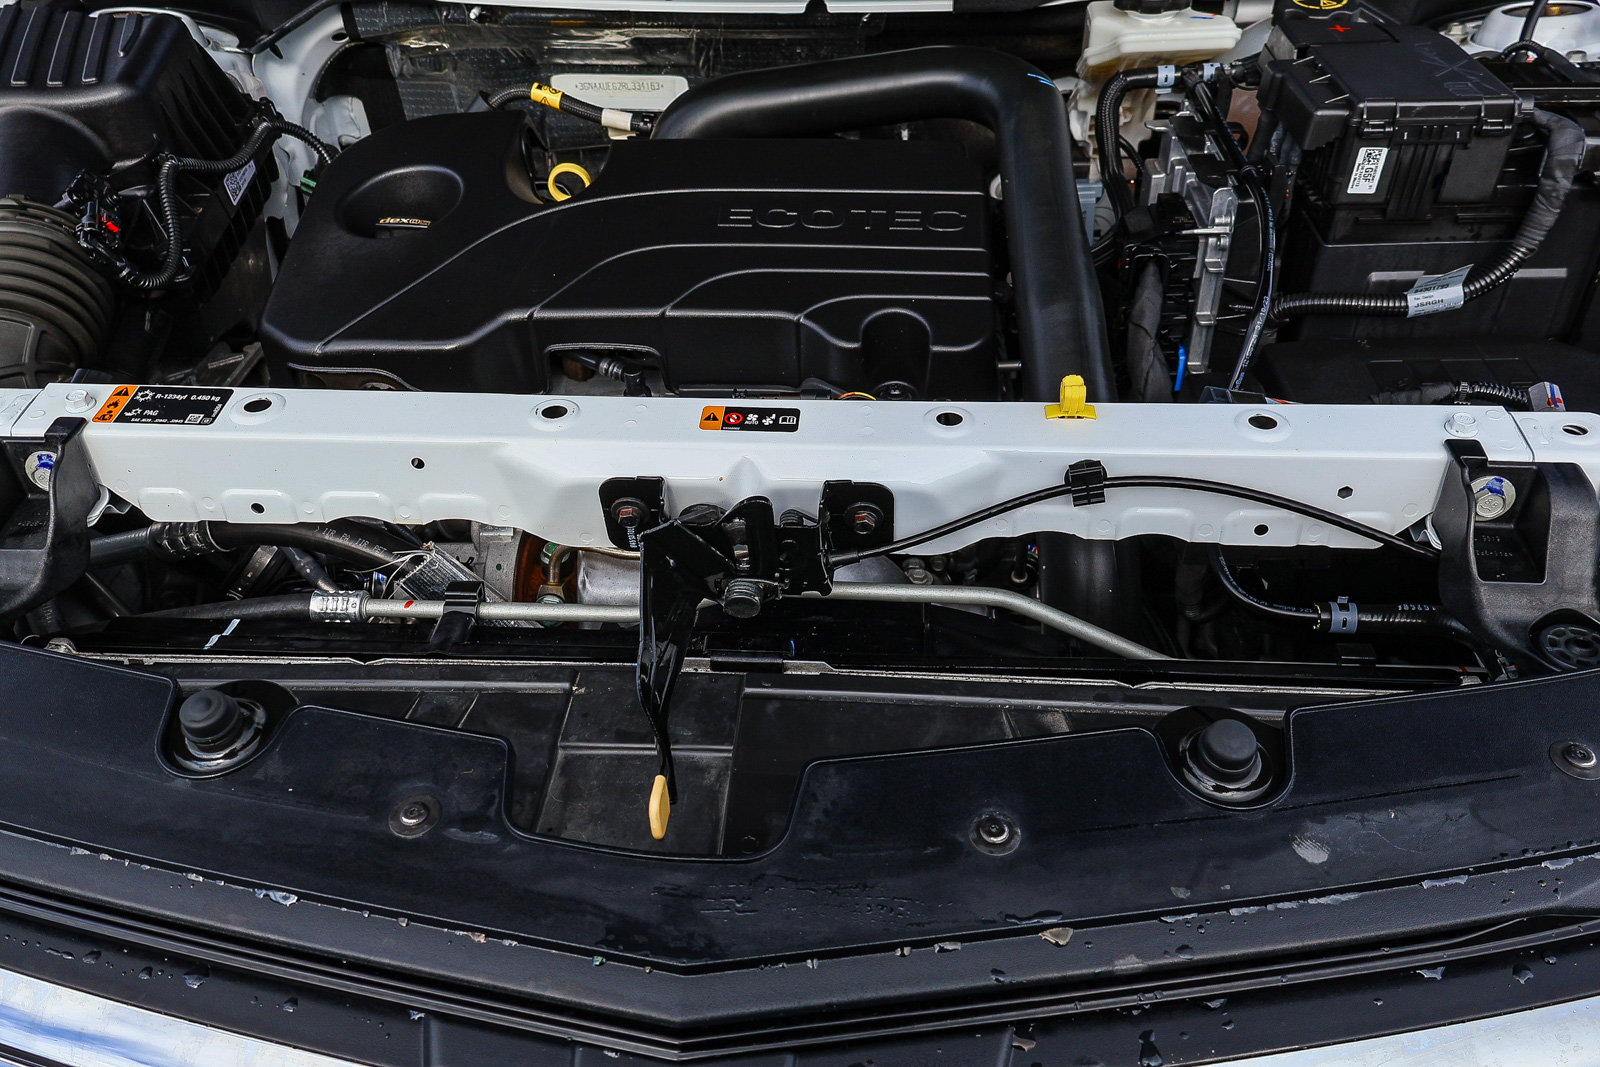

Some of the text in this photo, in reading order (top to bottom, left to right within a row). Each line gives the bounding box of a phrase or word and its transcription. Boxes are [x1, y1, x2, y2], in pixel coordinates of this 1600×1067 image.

[1362, 167, 1374, 183] G5F
[717, 208, 967, 232] ECOTEC
[1415, 299, 1444, 308] JSRGH
[372, 544, 388, 555] PET
